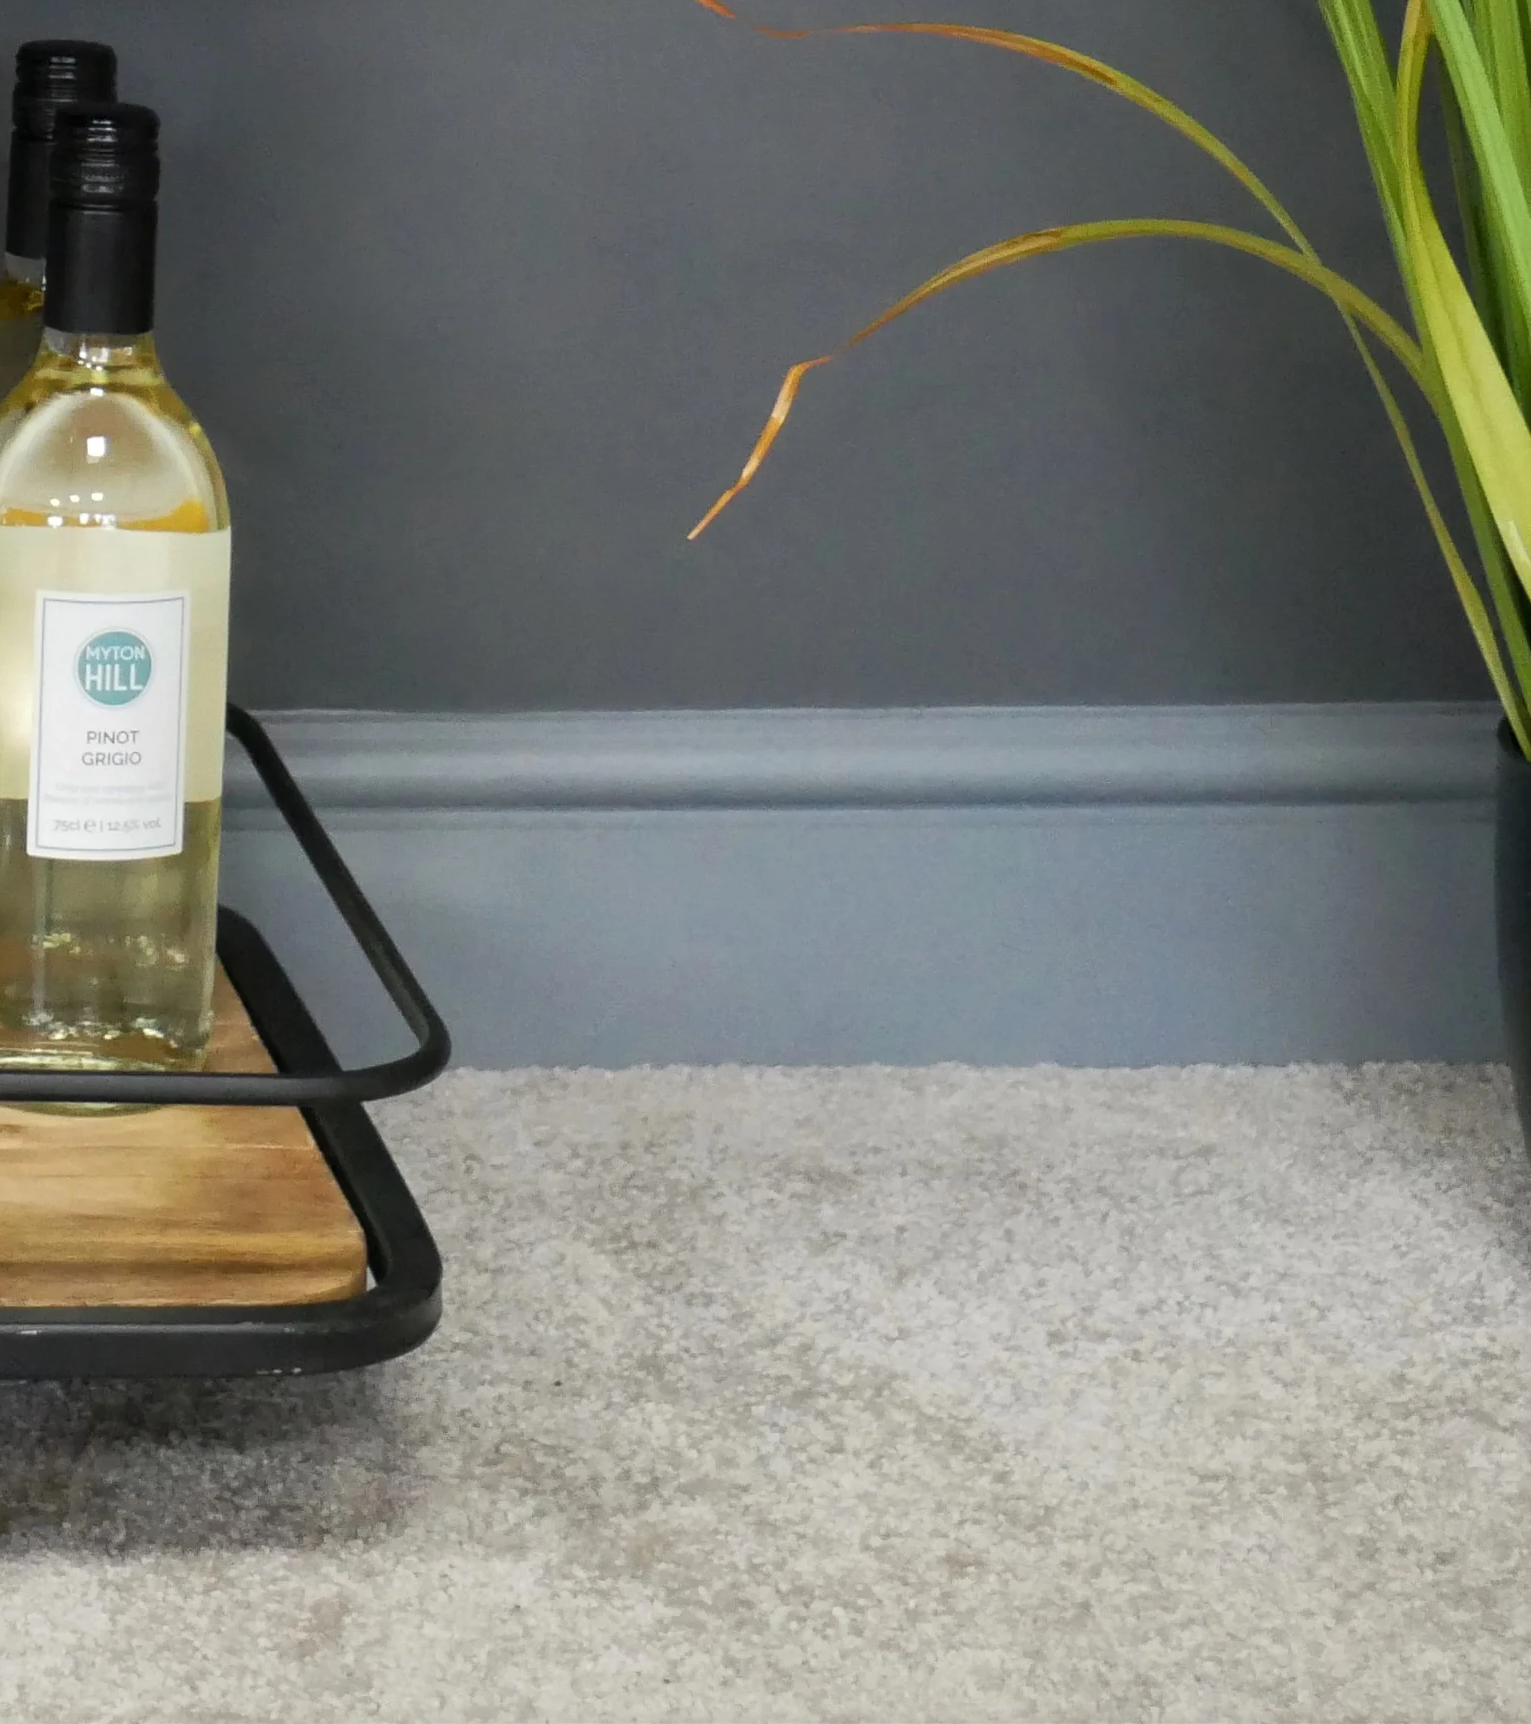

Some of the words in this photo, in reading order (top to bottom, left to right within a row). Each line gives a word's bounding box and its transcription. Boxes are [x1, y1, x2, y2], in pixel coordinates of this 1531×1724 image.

[85, 645, 146, 661] MYTON
[85, 663, 145, 692] HILL
[86, 729, 140, 745] PINOT
[81, 751, 143, 766] GRIGIO
